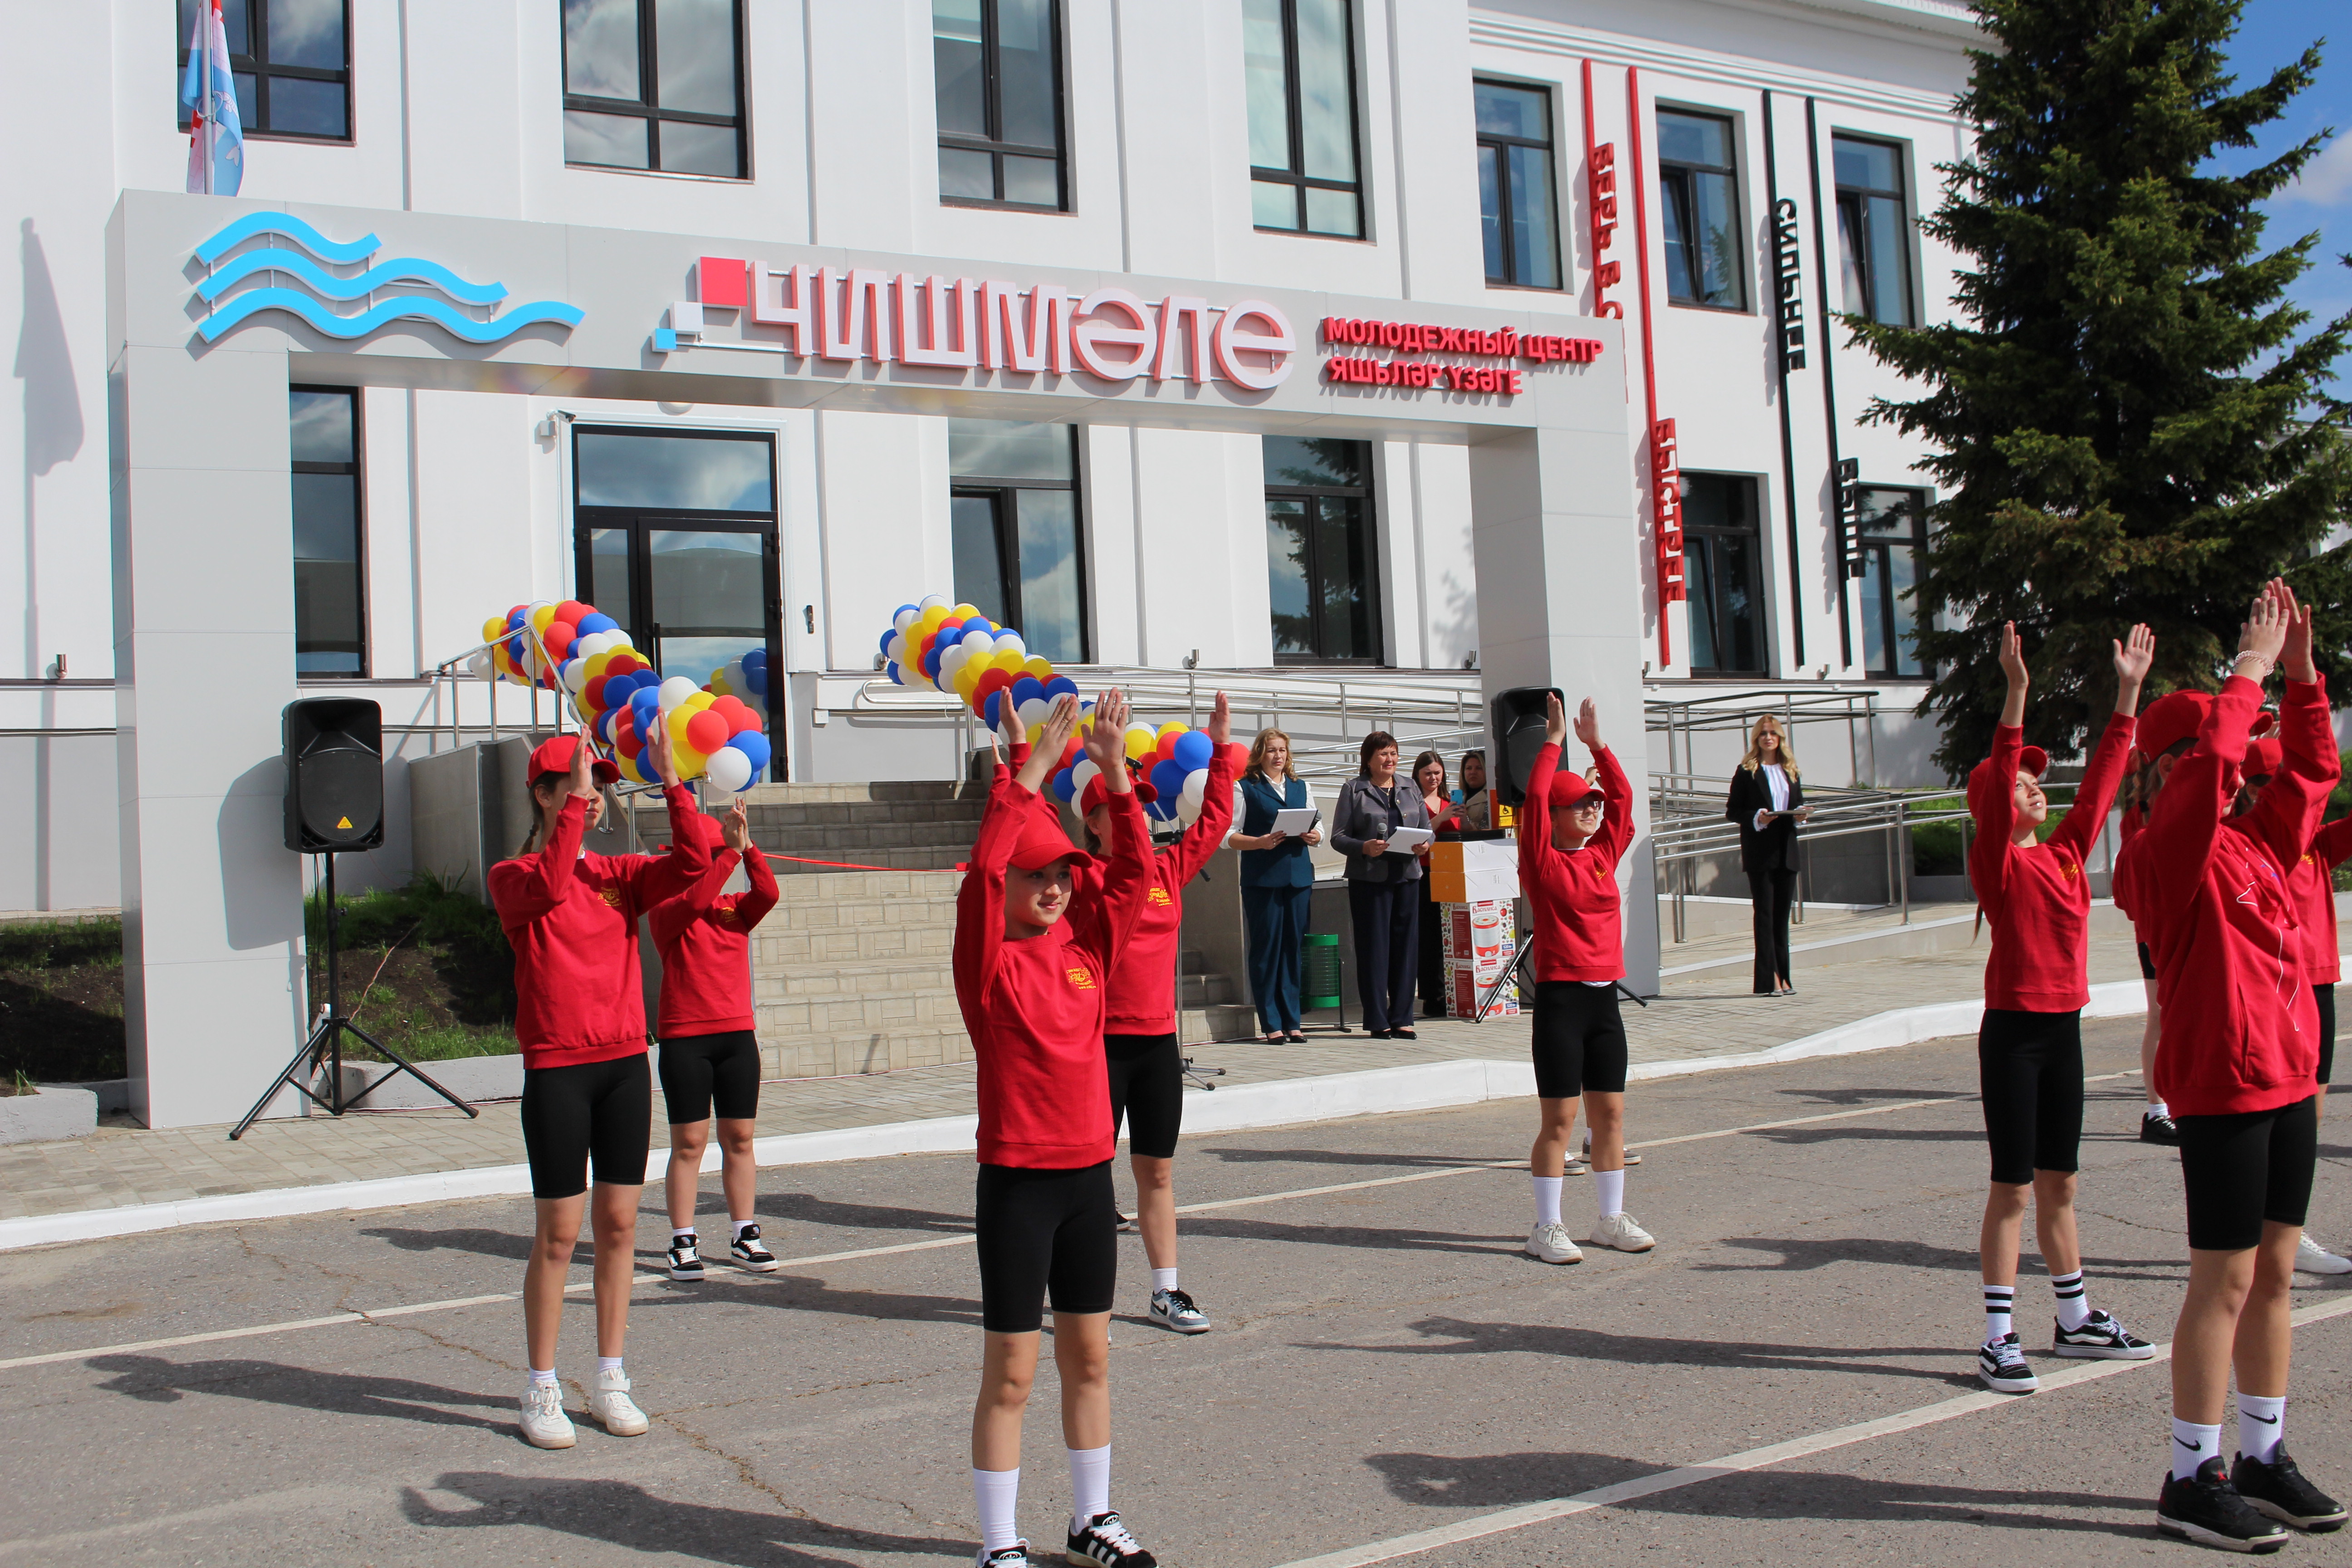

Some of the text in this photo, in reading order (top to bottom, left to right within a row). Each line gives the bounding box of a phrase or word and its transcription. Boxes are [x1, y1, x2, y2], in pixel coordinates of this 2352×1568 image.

[1591, 142, 1618, 250] ВЕРЬ
[1596, 260, 1621, 289] В
[1773, 198, 1806, 370] СИЛЬНЕЕ
[1323, 316, 1604, 363] МОЛОДЕЖНЫЙ ЦЕНТР
[1654, 417, 1686, 603] БЫСТРЕЕ
[1834, 457, 1866, 580] ВЫШЕ
